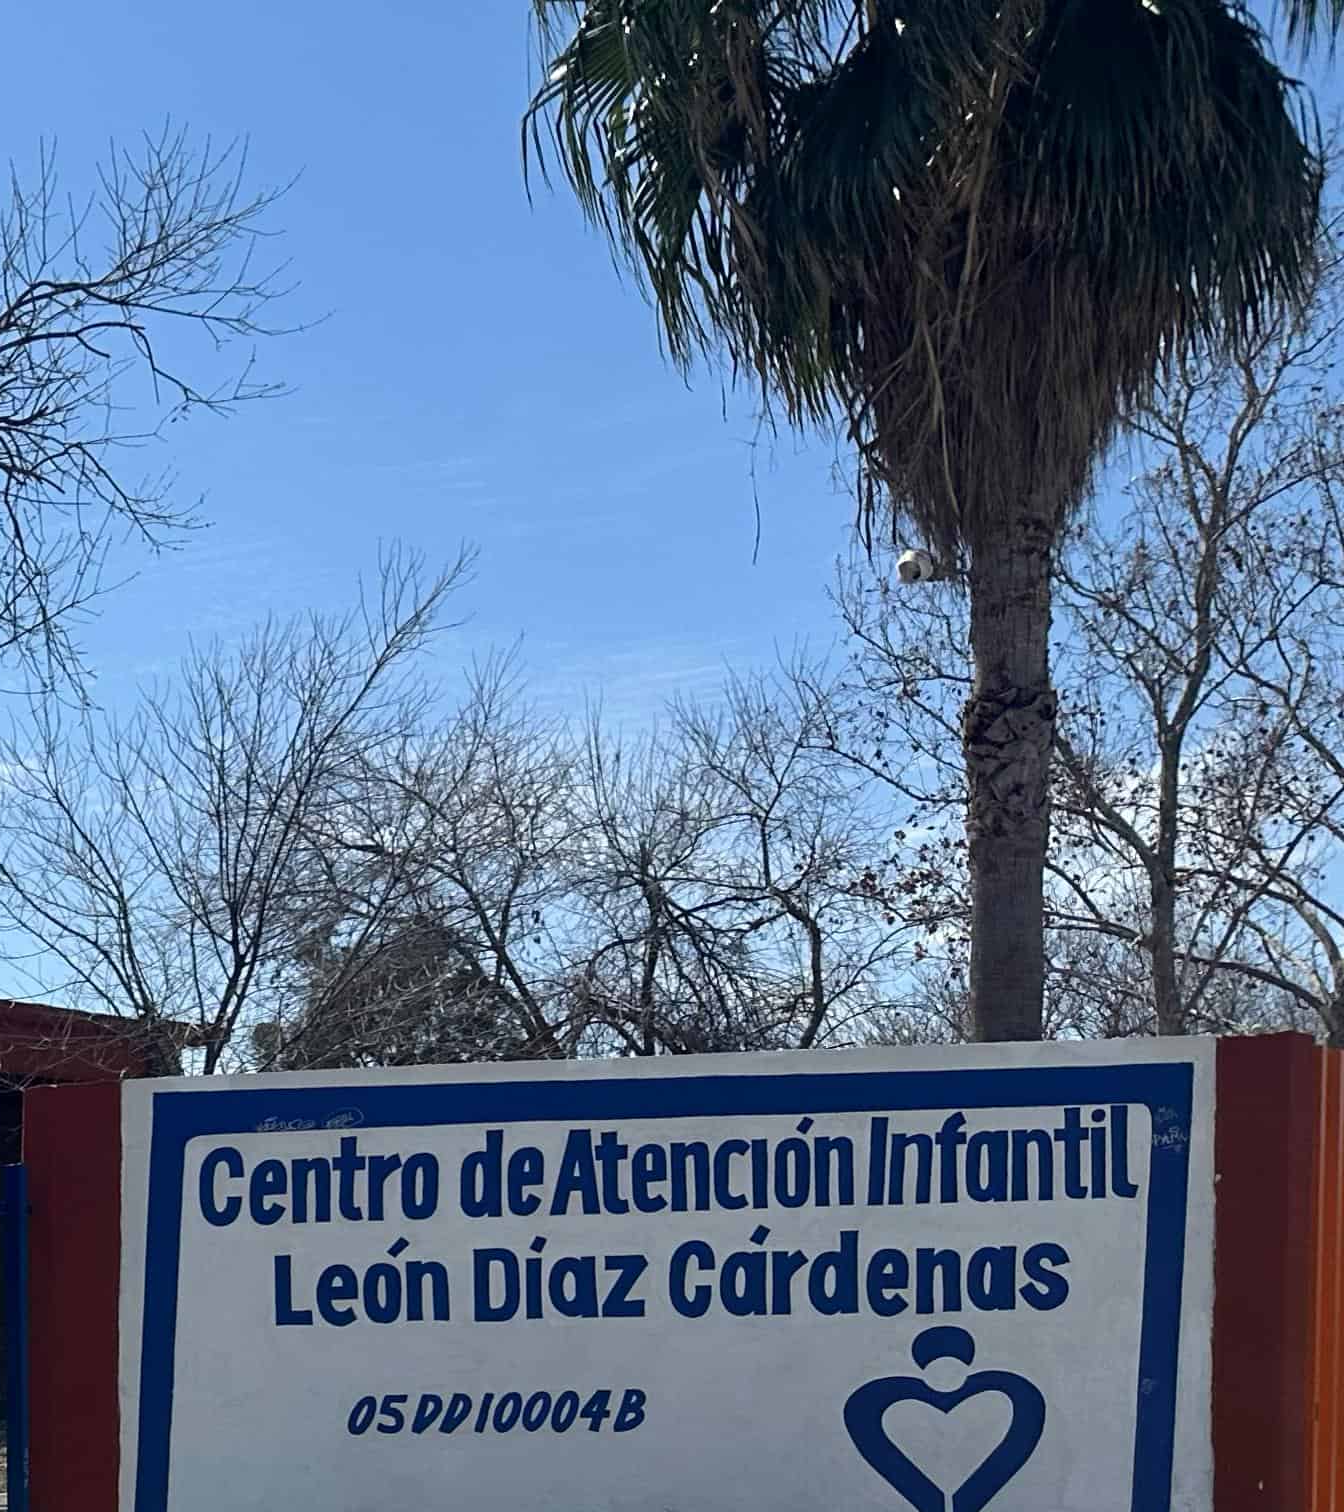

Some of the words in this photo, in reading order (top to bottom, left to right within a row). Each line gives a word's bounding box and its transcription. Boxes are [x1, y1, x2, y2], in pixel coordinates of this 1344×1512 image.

[198, 1134, 440, 1228] Centro
[459, 1127, 546, 1219] de
[548, 1117, 855, 1217] Atención
[866, 1103, 1142, 1207] Infantil
[273, 1236, 451, 1328] León
[472, 1236, 650, 1324] Díaz
[667, 1223, 1072, 1320] Cárdenas
